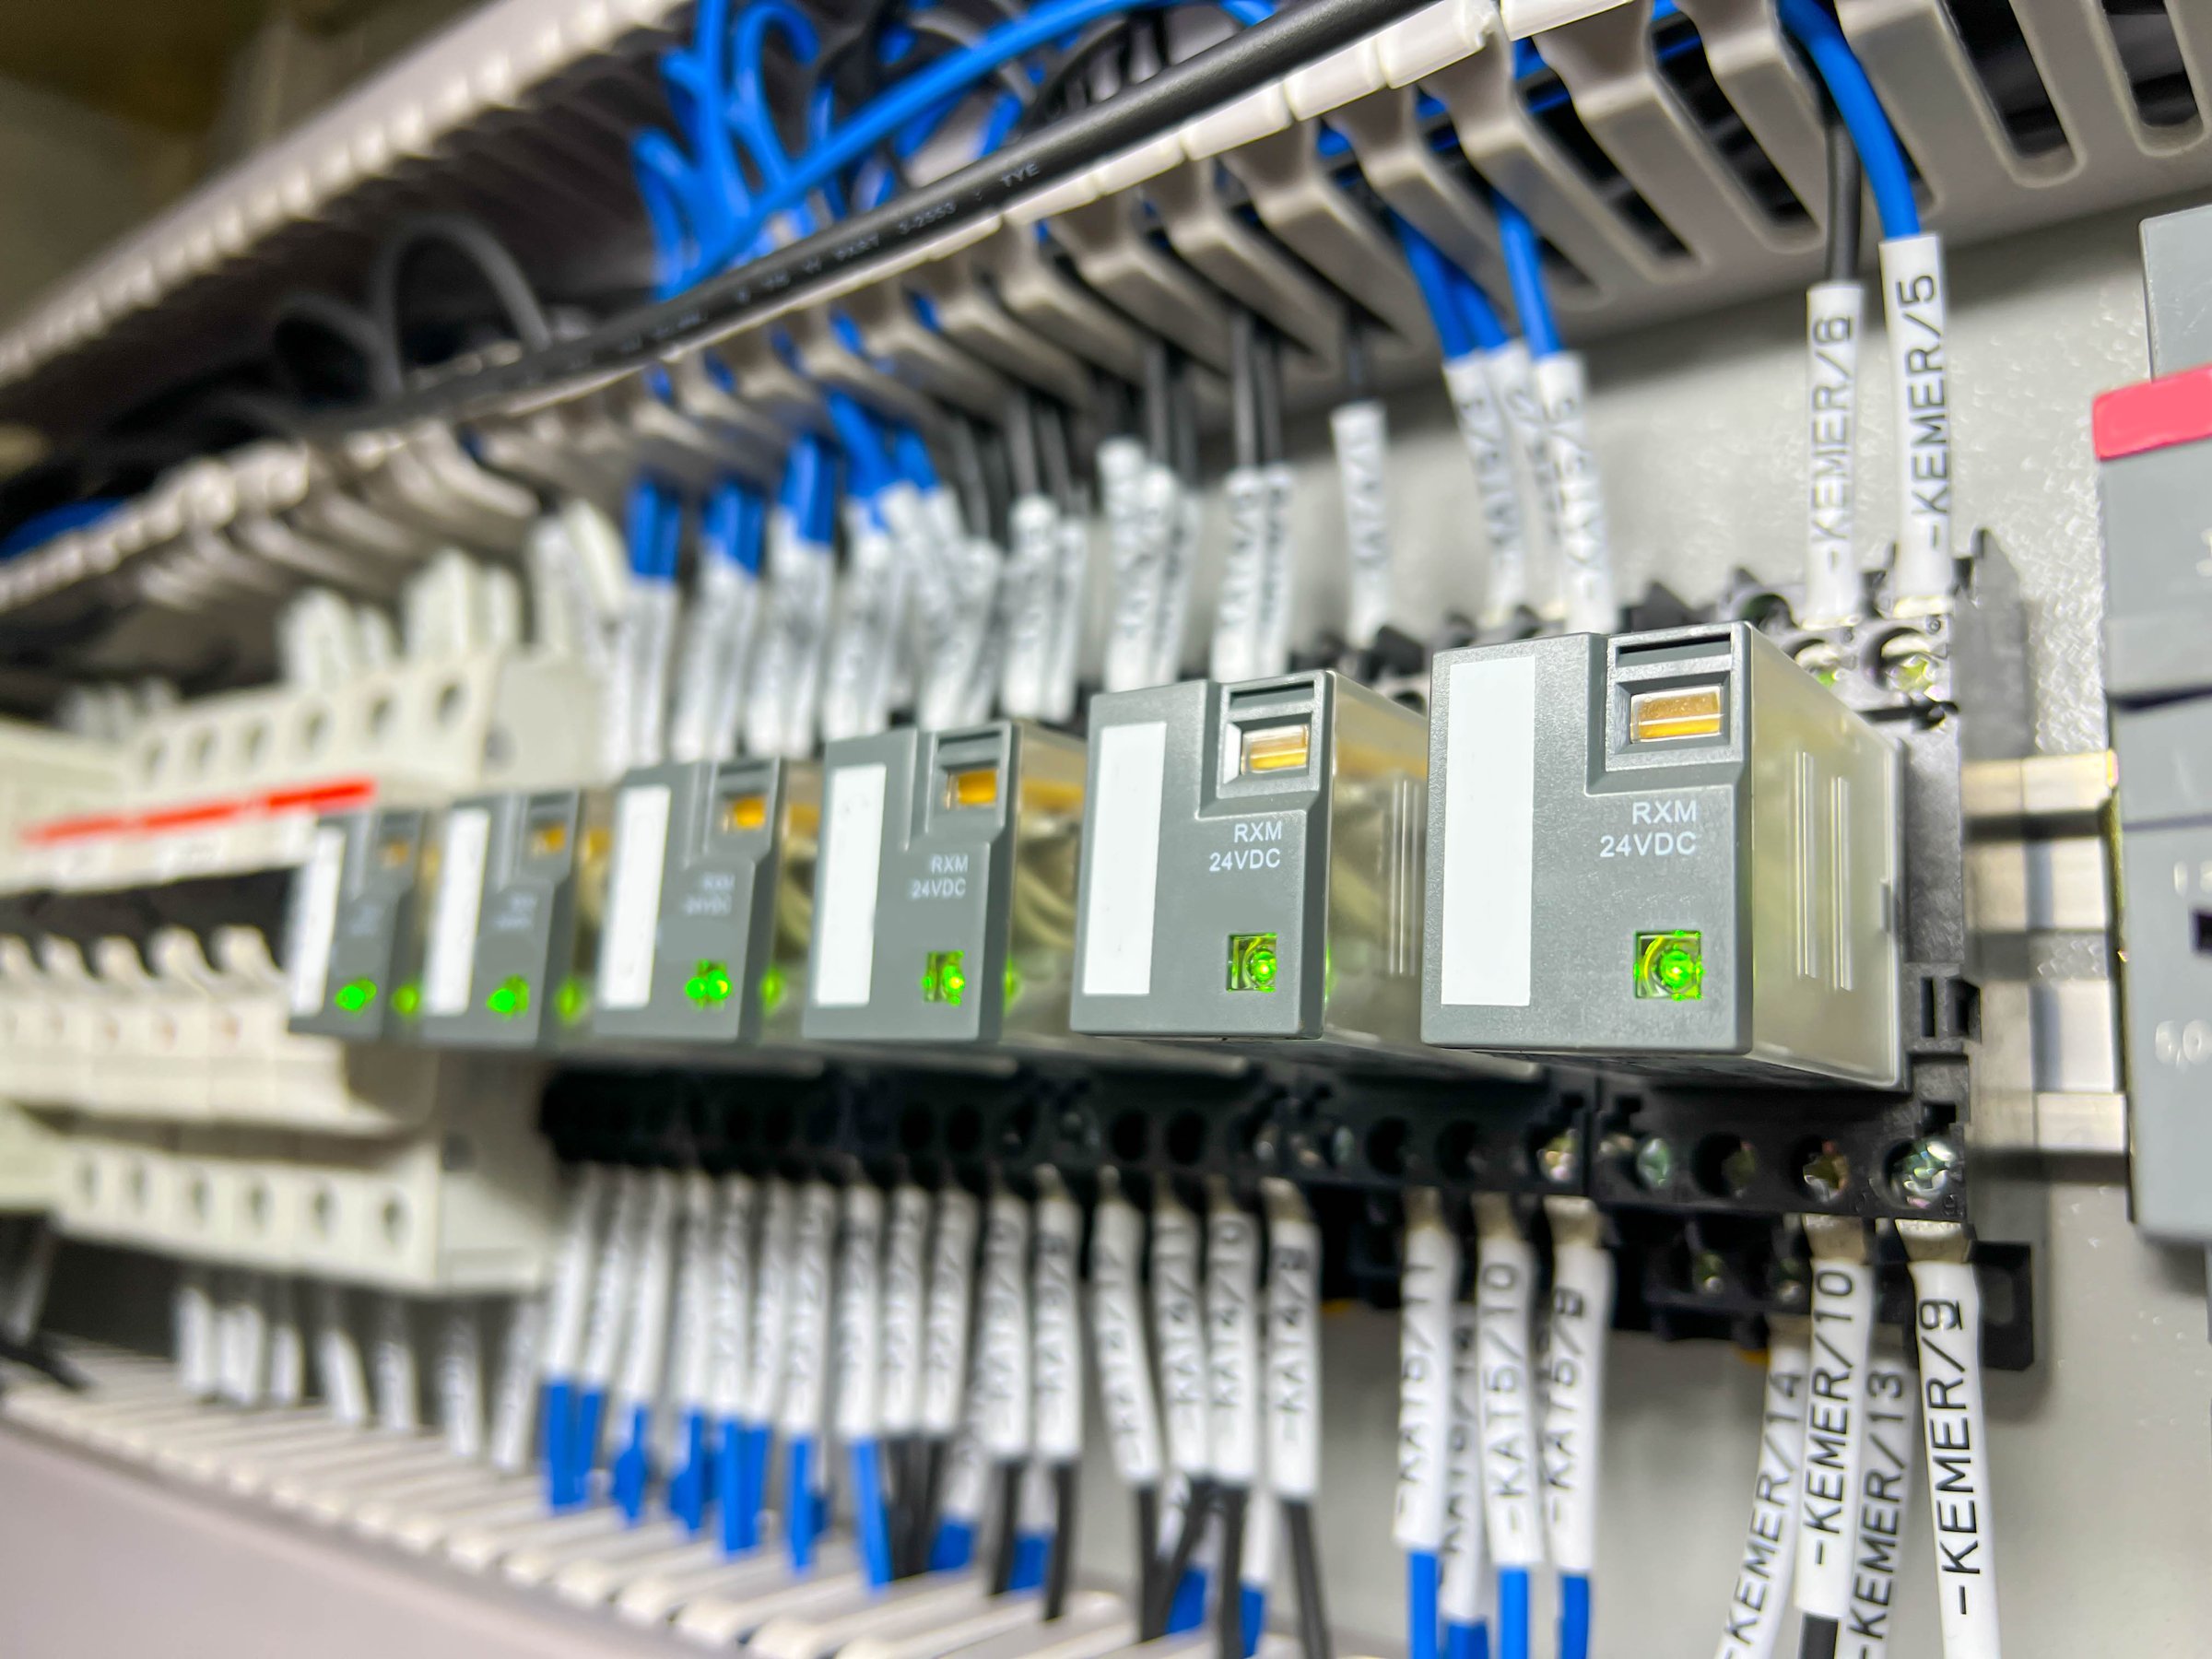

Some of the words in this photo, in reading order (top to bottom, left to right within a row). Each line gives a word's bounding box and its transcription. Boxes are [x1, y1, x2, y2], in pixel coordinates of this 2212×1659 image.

[1895, 275, 1948, 550] -KEMER/5
[1811, 316, 1852, 572] -KEMER/6
[1631, 800, 1697, 825] RXM
[1234, 820, 1282, 842] RXM
[1600, 831, 1697, 857] 24VDC
[931, 853, 969, 874] RXM
[1209, 848, 1280, 871] 24VDC
[911, 877, 967, 900] 24VDC
[1803, 1269, 1854, 1566] -KEMER/10
[1918, 1298, 1981, 1615] -KEMER/9
